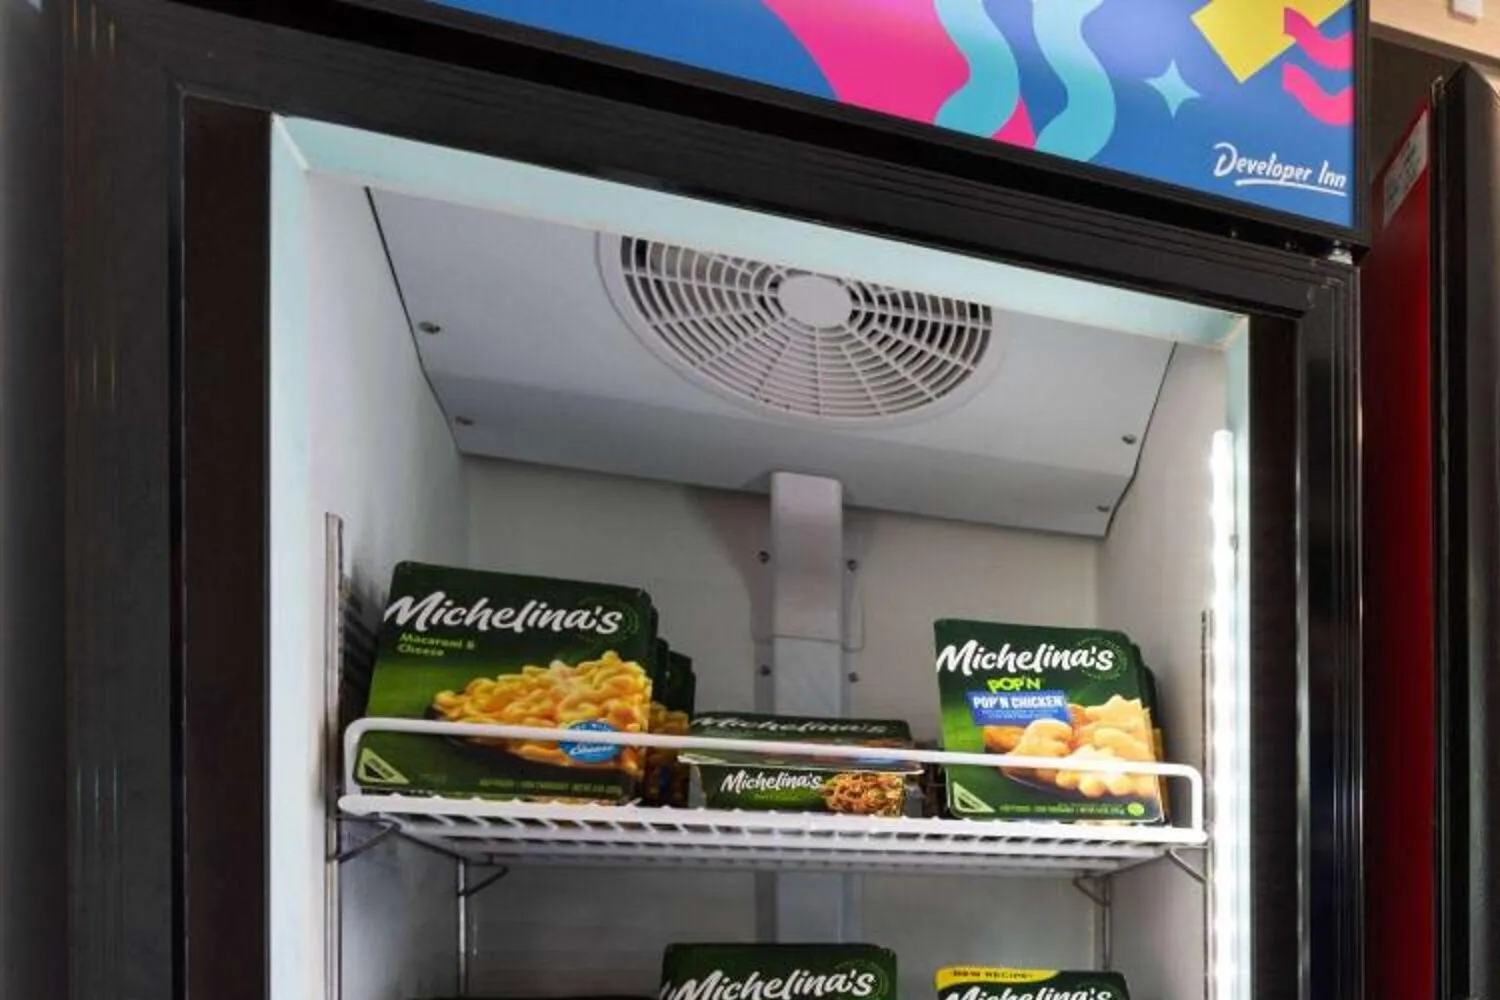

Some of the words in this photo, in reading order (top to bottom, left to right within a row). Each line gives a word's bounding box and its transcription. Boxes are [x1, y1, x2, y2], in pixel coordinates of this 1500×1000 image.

[1213, 141, 1313, 182] Developer
[1318, 160, 1348, 188] Inn
[383, 590, 623, 634] Michelina's
[936, 639, 1115, 676] Michelina's
[720, 769, 822, 794] Michelina's
